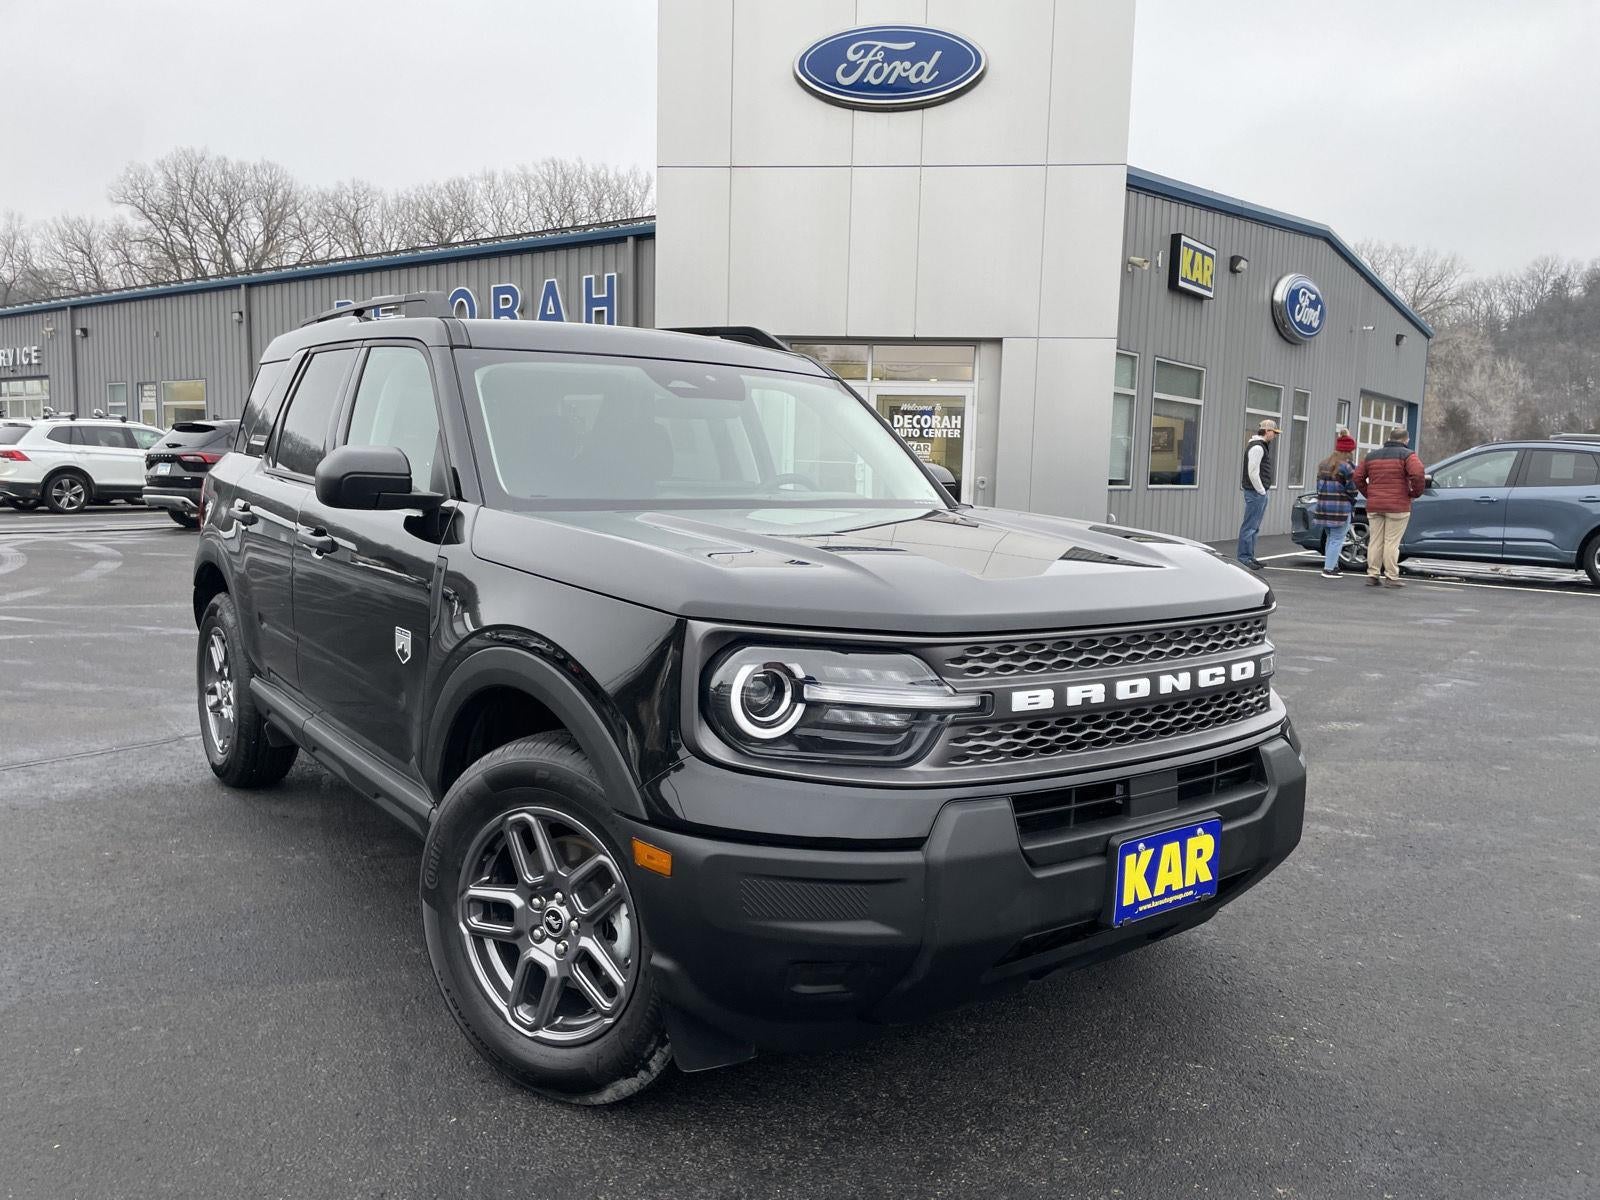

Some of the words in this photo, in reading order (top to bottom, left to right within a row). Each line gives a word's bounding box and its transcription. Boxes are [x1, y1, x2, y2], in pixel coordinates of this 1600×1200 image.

[835, 40, 943, 86] Ford
[1181, 246, 1214, 288] KAR
[335, 273, 617, 326] ORAH
[1294, 288, 1321, 329] Ford
[893, 415, 962, 428] DECORAH
[901, 403, 933, 411] Welcome
[895, 429, 920, 437] AUTO
[923, 429, 961, 438] CENTER
[1011, 661, 1255, 712] BRONCO
[1122, 833, 1215, 907] KAR
